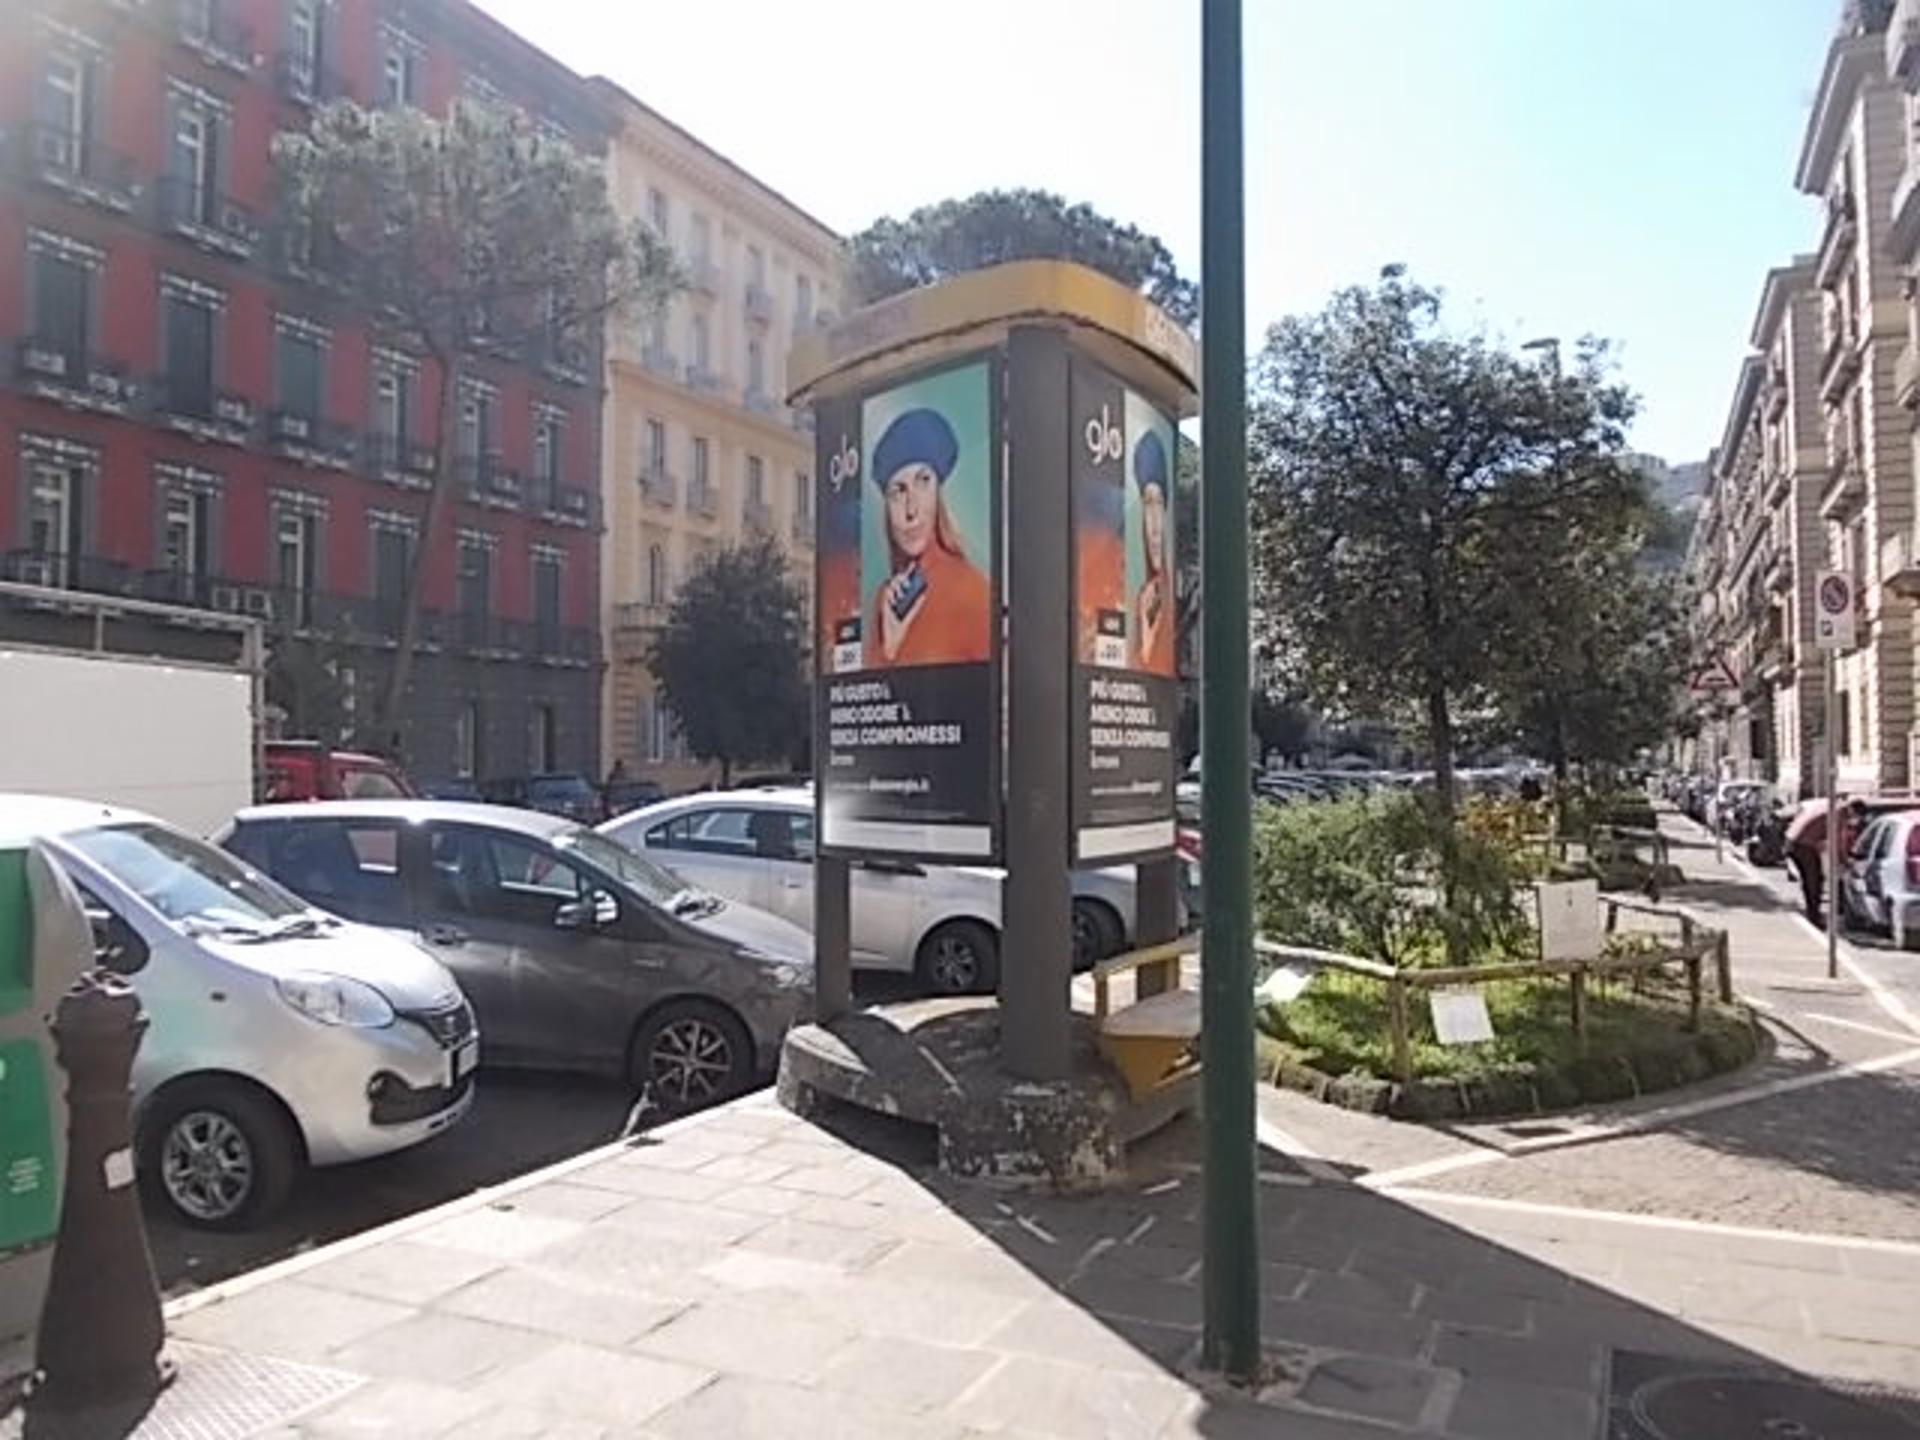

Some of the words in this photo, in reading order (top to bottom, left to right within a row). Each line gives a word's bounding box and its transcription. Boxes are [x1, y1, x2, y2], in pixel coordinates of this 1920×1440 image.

[830, 433, 859, 492] glo
[1086, 404, 1122, 464] glo
[861, 725, 961, 745] COMPROMESSI
